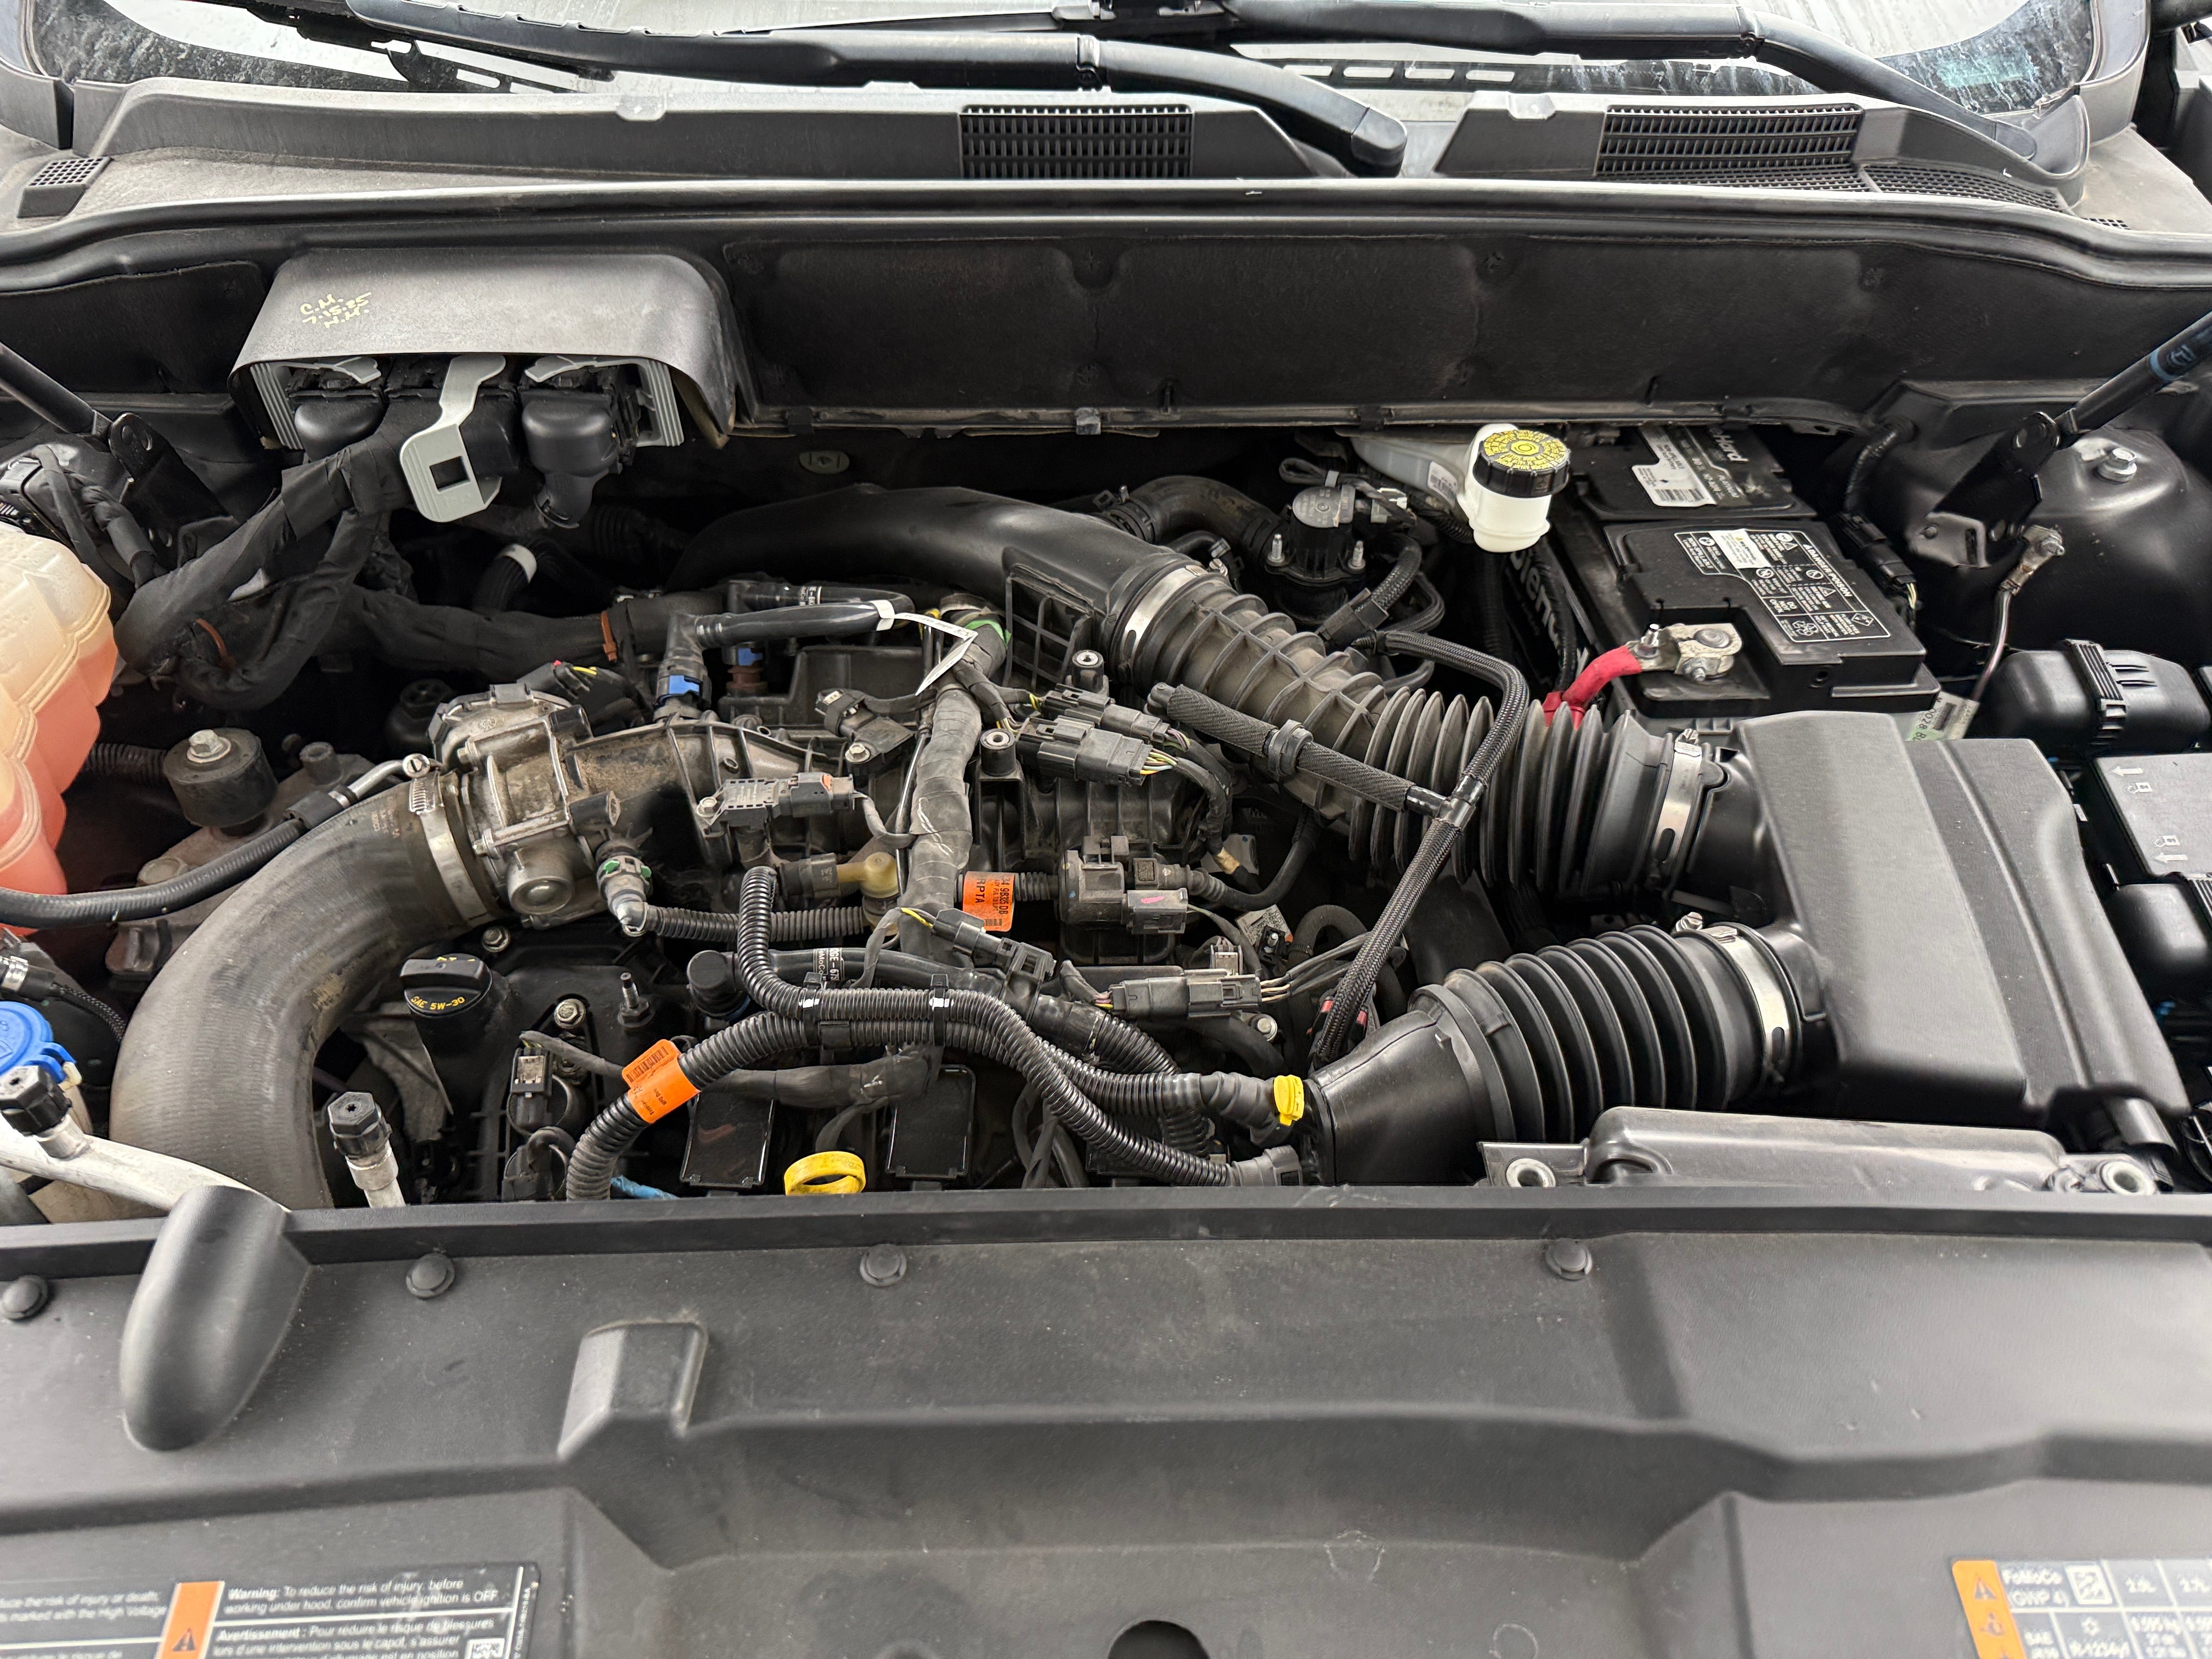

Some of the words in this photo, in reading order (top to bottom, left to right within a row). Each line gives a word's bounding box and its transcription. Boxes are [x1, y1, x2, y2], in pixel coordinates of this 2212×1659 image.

[975, 879, 986, 904] RPTA
[411, 996, 428, 1008] SAE
[430, 996, 465, 1010] 5W-30
[2002, 1568, 2063, 1585] FoMoCo
[228, 1585, 280, 1601] Warning:
[284, 1584, 296, 1598] To
[299, 1584, 336, 1597] reduce
[338, 1583, 356, 1595] the
[359, 1580, 377, 1592] risk
[381, 1579, 392, 1592] of
[428, 1577, 464, 1591] before
